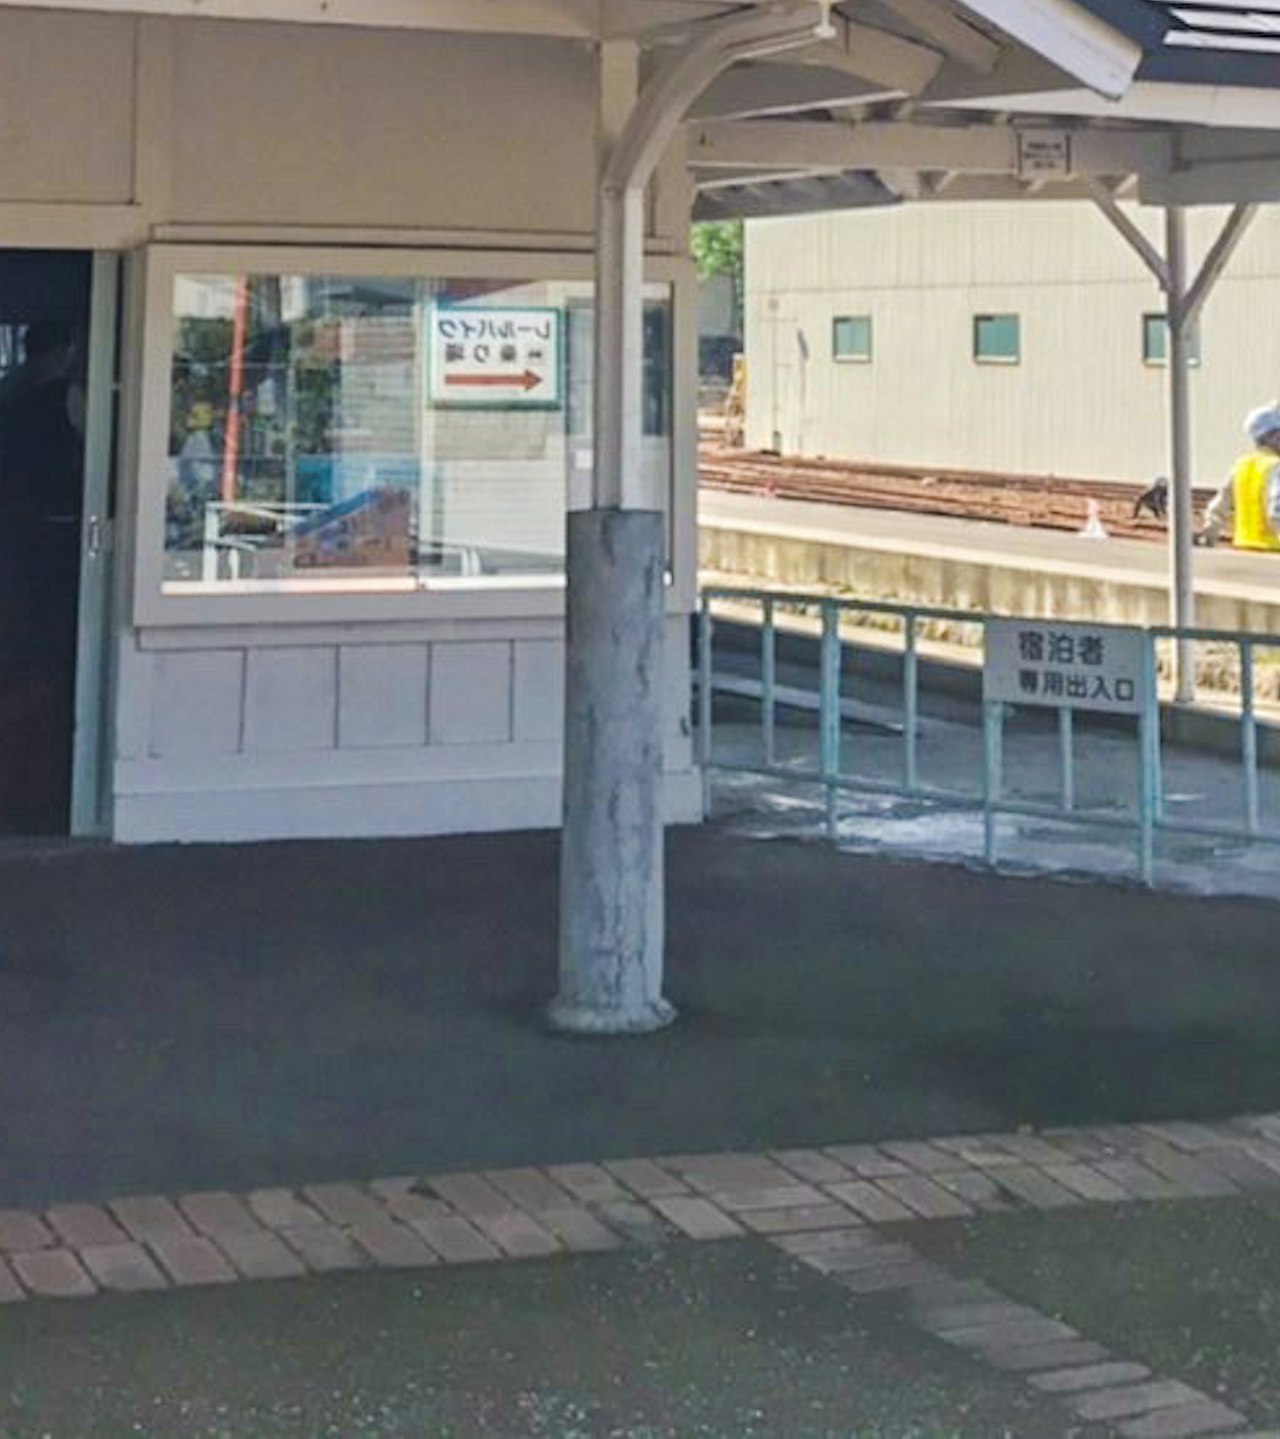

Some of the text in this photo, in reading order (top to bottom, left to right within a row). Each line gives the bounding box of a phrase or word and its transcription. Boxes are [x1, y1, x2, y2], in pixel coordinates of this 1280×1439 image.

[1018, 630, 1105, 666] 宿泊者
[1018, 669, 1135, 702] 専用出入口
